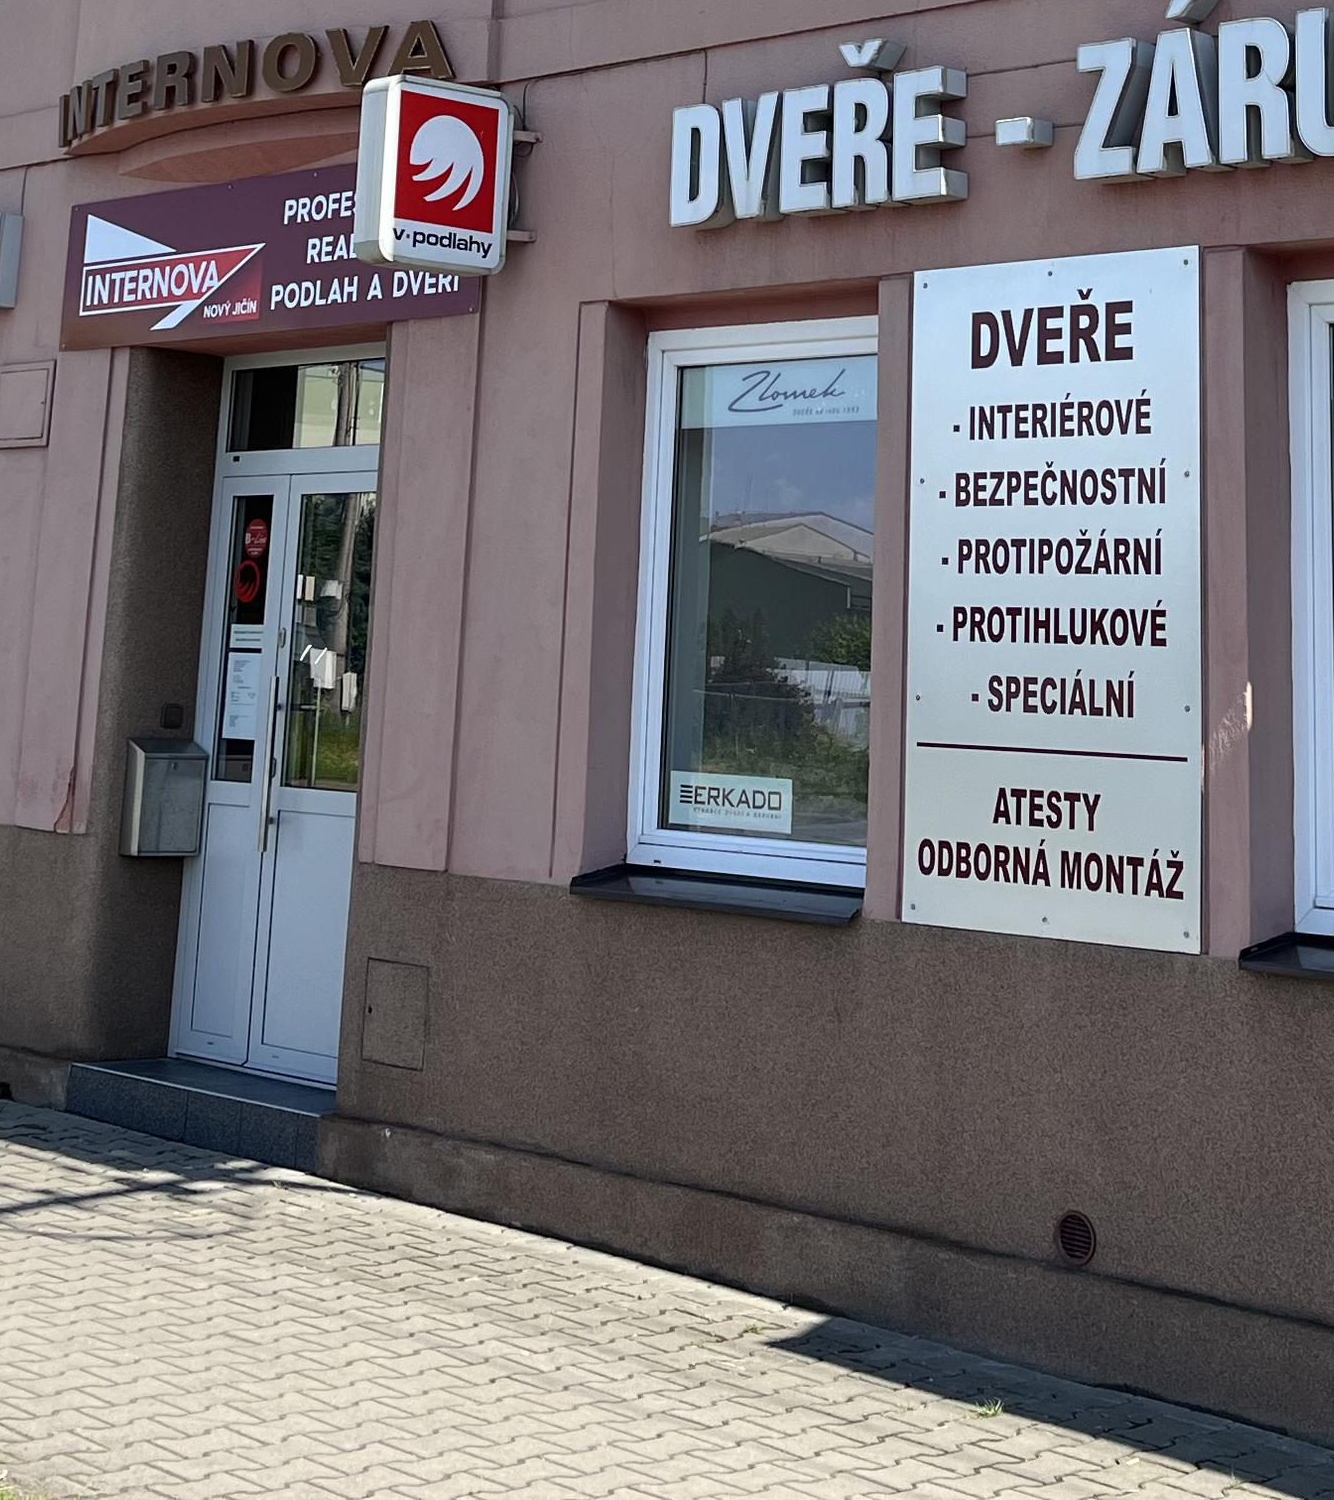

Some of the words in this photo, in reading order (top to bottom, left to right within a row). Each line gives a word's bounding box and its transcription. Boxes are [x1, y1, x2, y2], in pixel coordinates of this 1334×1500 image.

[58, 20, 456, 148] INTERNOVA
[670, 39, 955, 228] DVEŘE
[284, 190, 357, 225] PROFE
[307, 233, 357, 264] REAL
[85, 260, 219, 307] INTERNOVA
[270, 275, 359, 311] PODLAH
[366, 273, 383, 301] A
[203, 300, 232, 319] NOVÝ
[232, 297, 258, 315] JIČÍN
[971, 288, 1134, 370] DVEŘE
[727, 368, 847, 413] Zlomek
[969, 389, 1152, 441] INTERIÉROVÉ
[955, 458, 1167, 508] BEZPEČNOSTNÍ
[957, 528, 1163, 576] PROTIPOŽÁRNÍ
[953, 600, 1167, 647] PROTIHLUKOVÉ
[987, 669, 1135, 718] SPECIÁLNÍ
[693, 785, 782, 811] ERKADO
[992, 787, 1101, 832] ATESTY
[918, 839, 1051, 887] ODBORNÁ
[1060, 848, 1185, 900] MONTÁŽ
